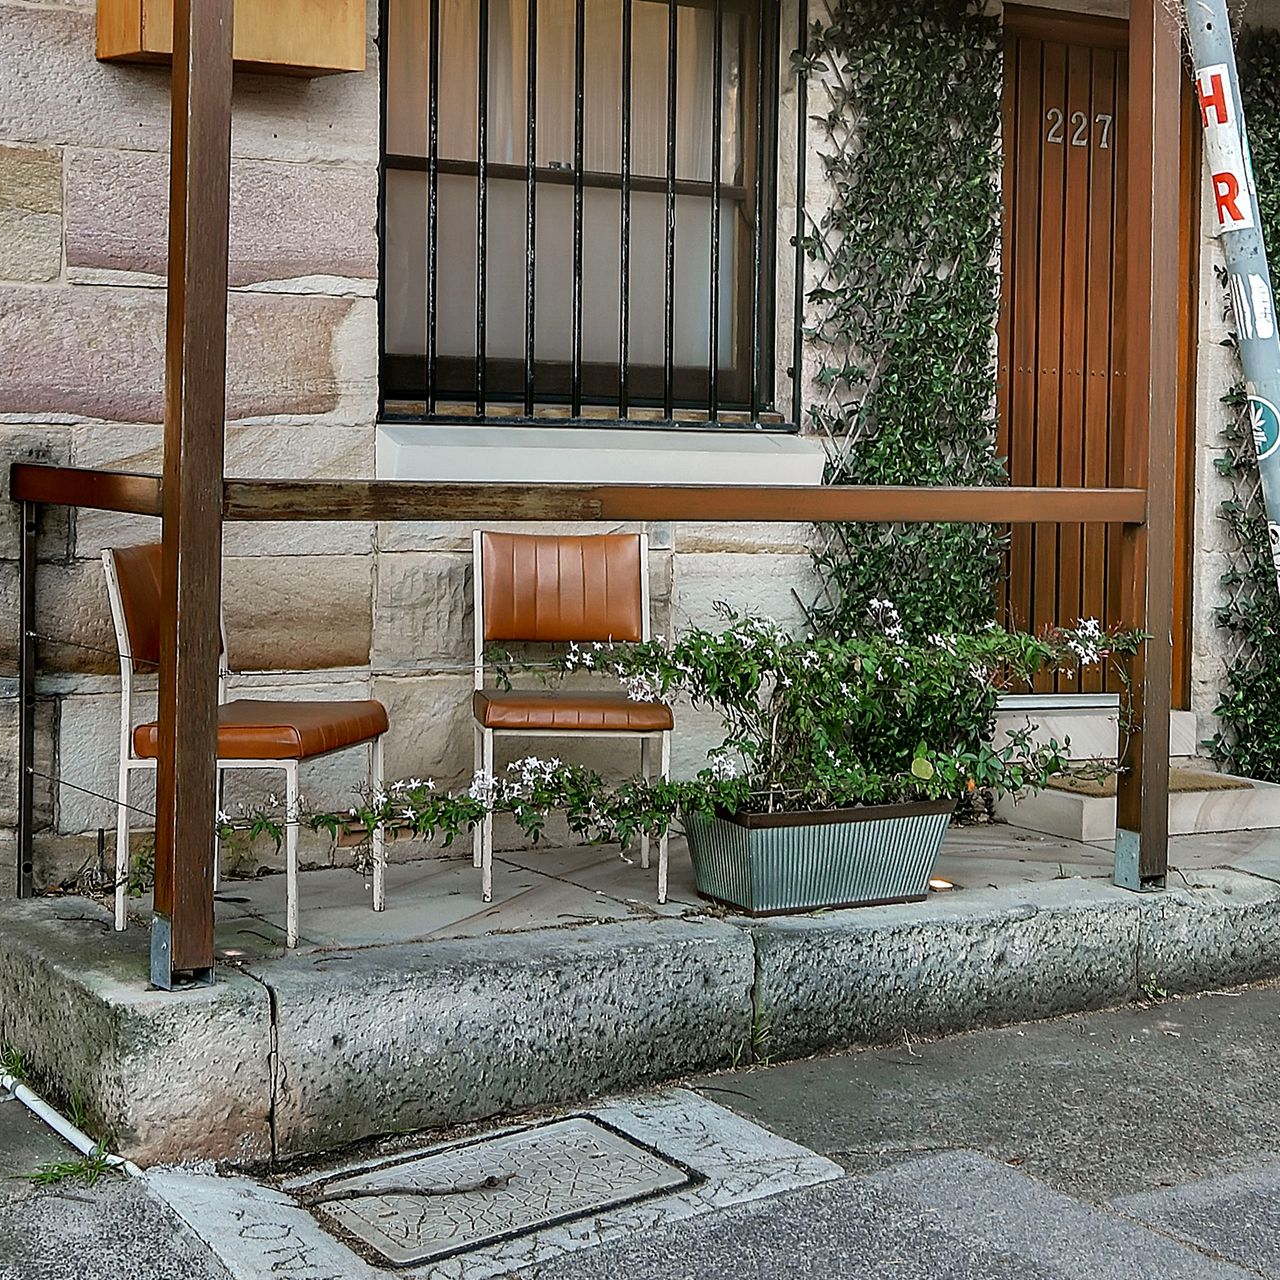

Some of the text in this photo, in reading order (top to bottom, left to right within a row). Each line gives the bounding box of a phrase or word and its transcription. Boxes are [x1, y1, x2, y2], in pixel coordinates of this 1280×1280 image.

[1197, 73, 1229, 128] H
[1046, 107, 1113, 149] 227
[1212, 171, 1246, 225] R
